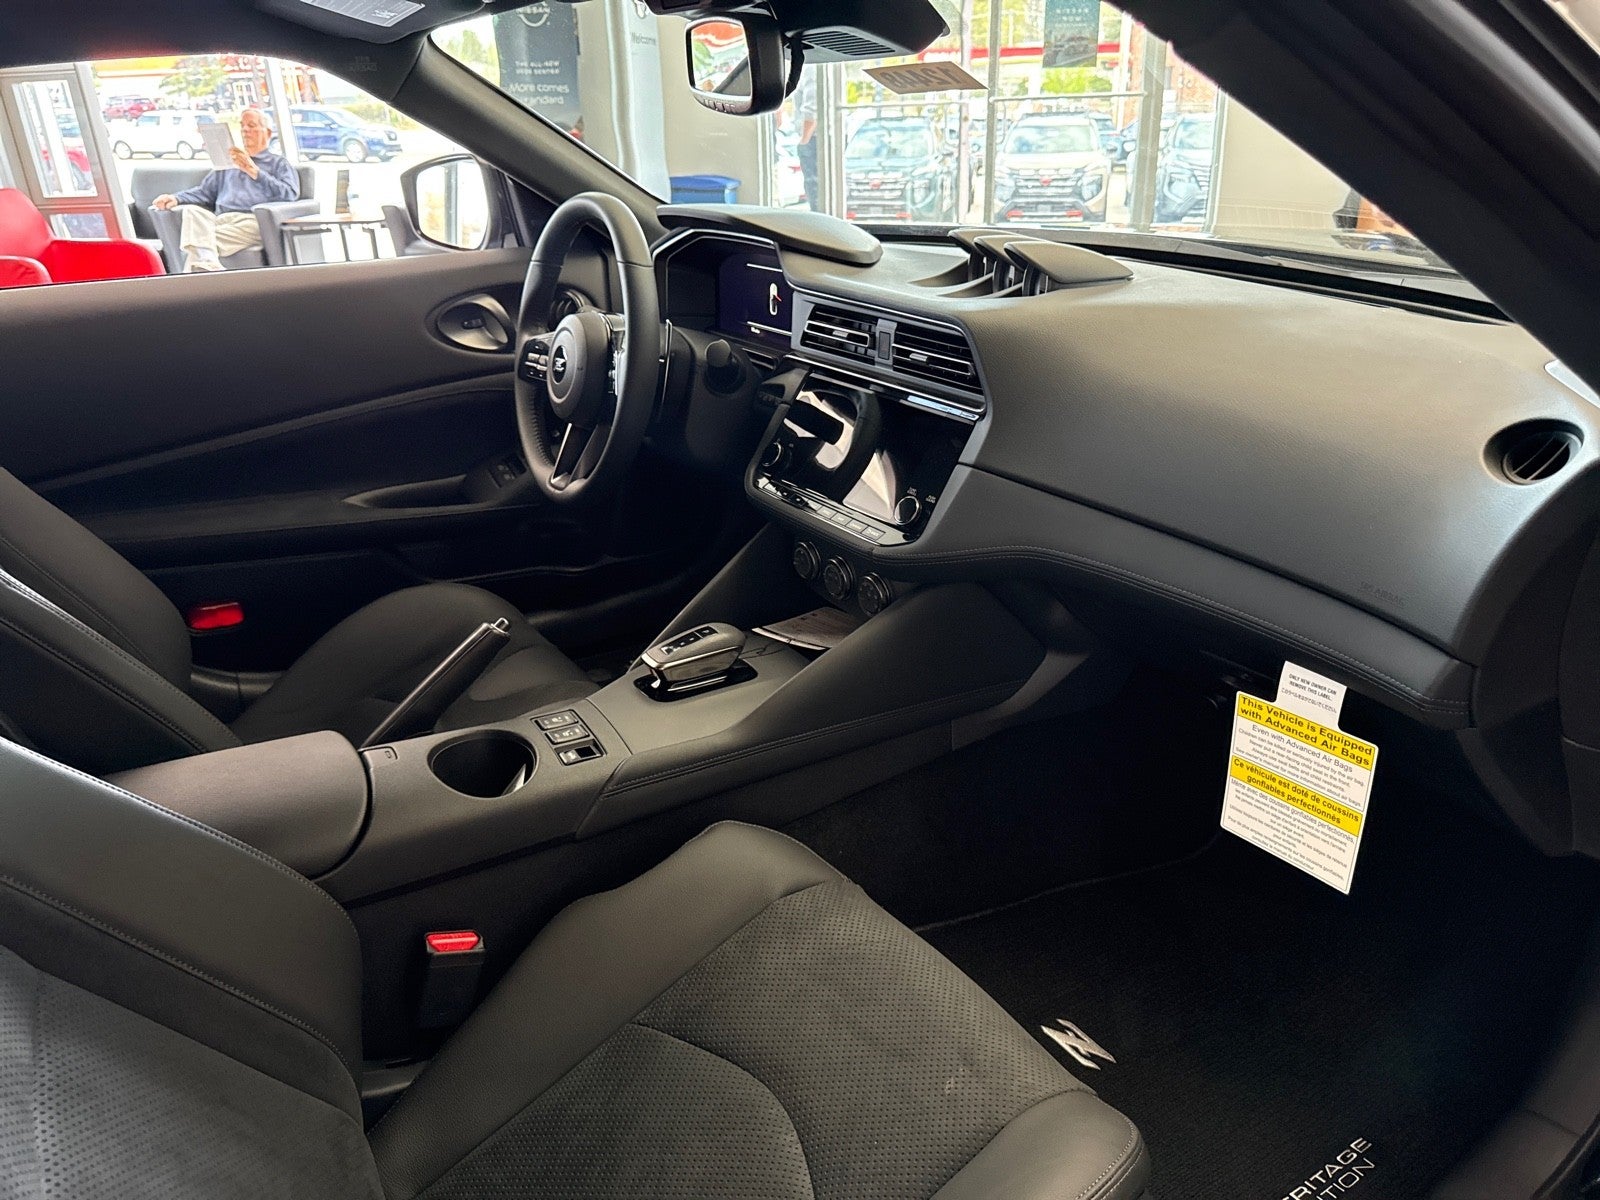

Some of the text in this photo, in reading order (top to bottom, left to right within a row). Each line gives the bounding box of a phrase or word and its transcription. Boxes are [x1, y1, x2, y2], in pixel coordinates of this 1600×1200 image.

[1240, 705, 1370, 767] with Advanced Air Bags
[1242, 696, 1372, 757] This Vehicle is Equipped
[1252, 724, 1353, 773] Even with Advanced Air Bags
[1233, 757, 1359, 822] Ce véhicule est doté de coussins
[1246, 773, 1285, 799] gonflables
[1286, 792, 1341, 825] perfectionnés
[1282, 1137, 1372, 1200] RITAGE
